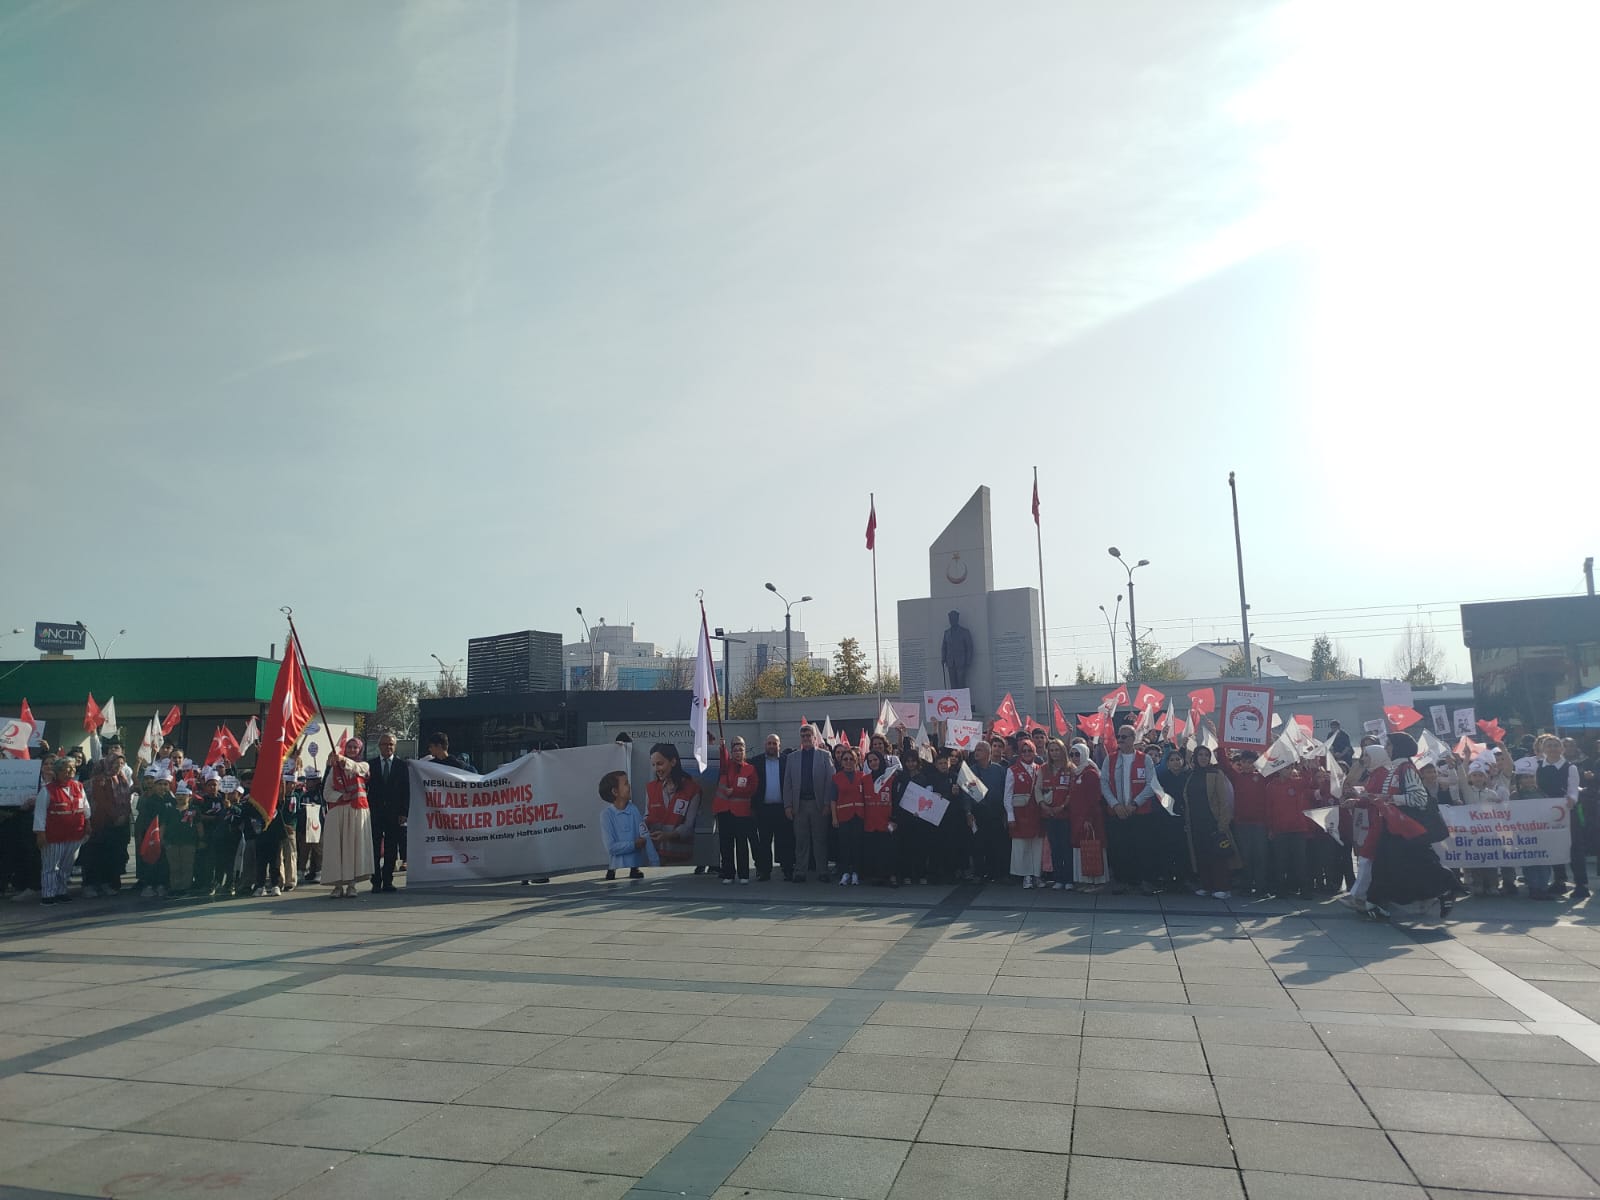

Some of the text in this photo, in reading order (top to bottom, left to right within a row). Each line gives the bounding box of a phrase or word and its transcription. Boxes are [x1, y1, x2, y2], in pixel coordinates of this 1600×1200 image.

[423, 779, 467, 789] NESİLLER
[425, 784, 533, 808] HİLALE ADANMIŞ
[426, 802, 563, 830] YÜREKLER DEĞİŞMEZ.
[1469, 809, 1511, 820] Kızılay
[543, 825, 562, 834] Kutlu
[563, 823, 586, 831] Olsun.
[1447, 825, 1469, 833] ara
[1472, 824, 1492, 835] gün
[1495, 820, 1550, 833] dostudur.
[1455, 834, 1538, 847] Bir damla kan
[1445, 848, 1549, 863] bir hayat kurtarır.
